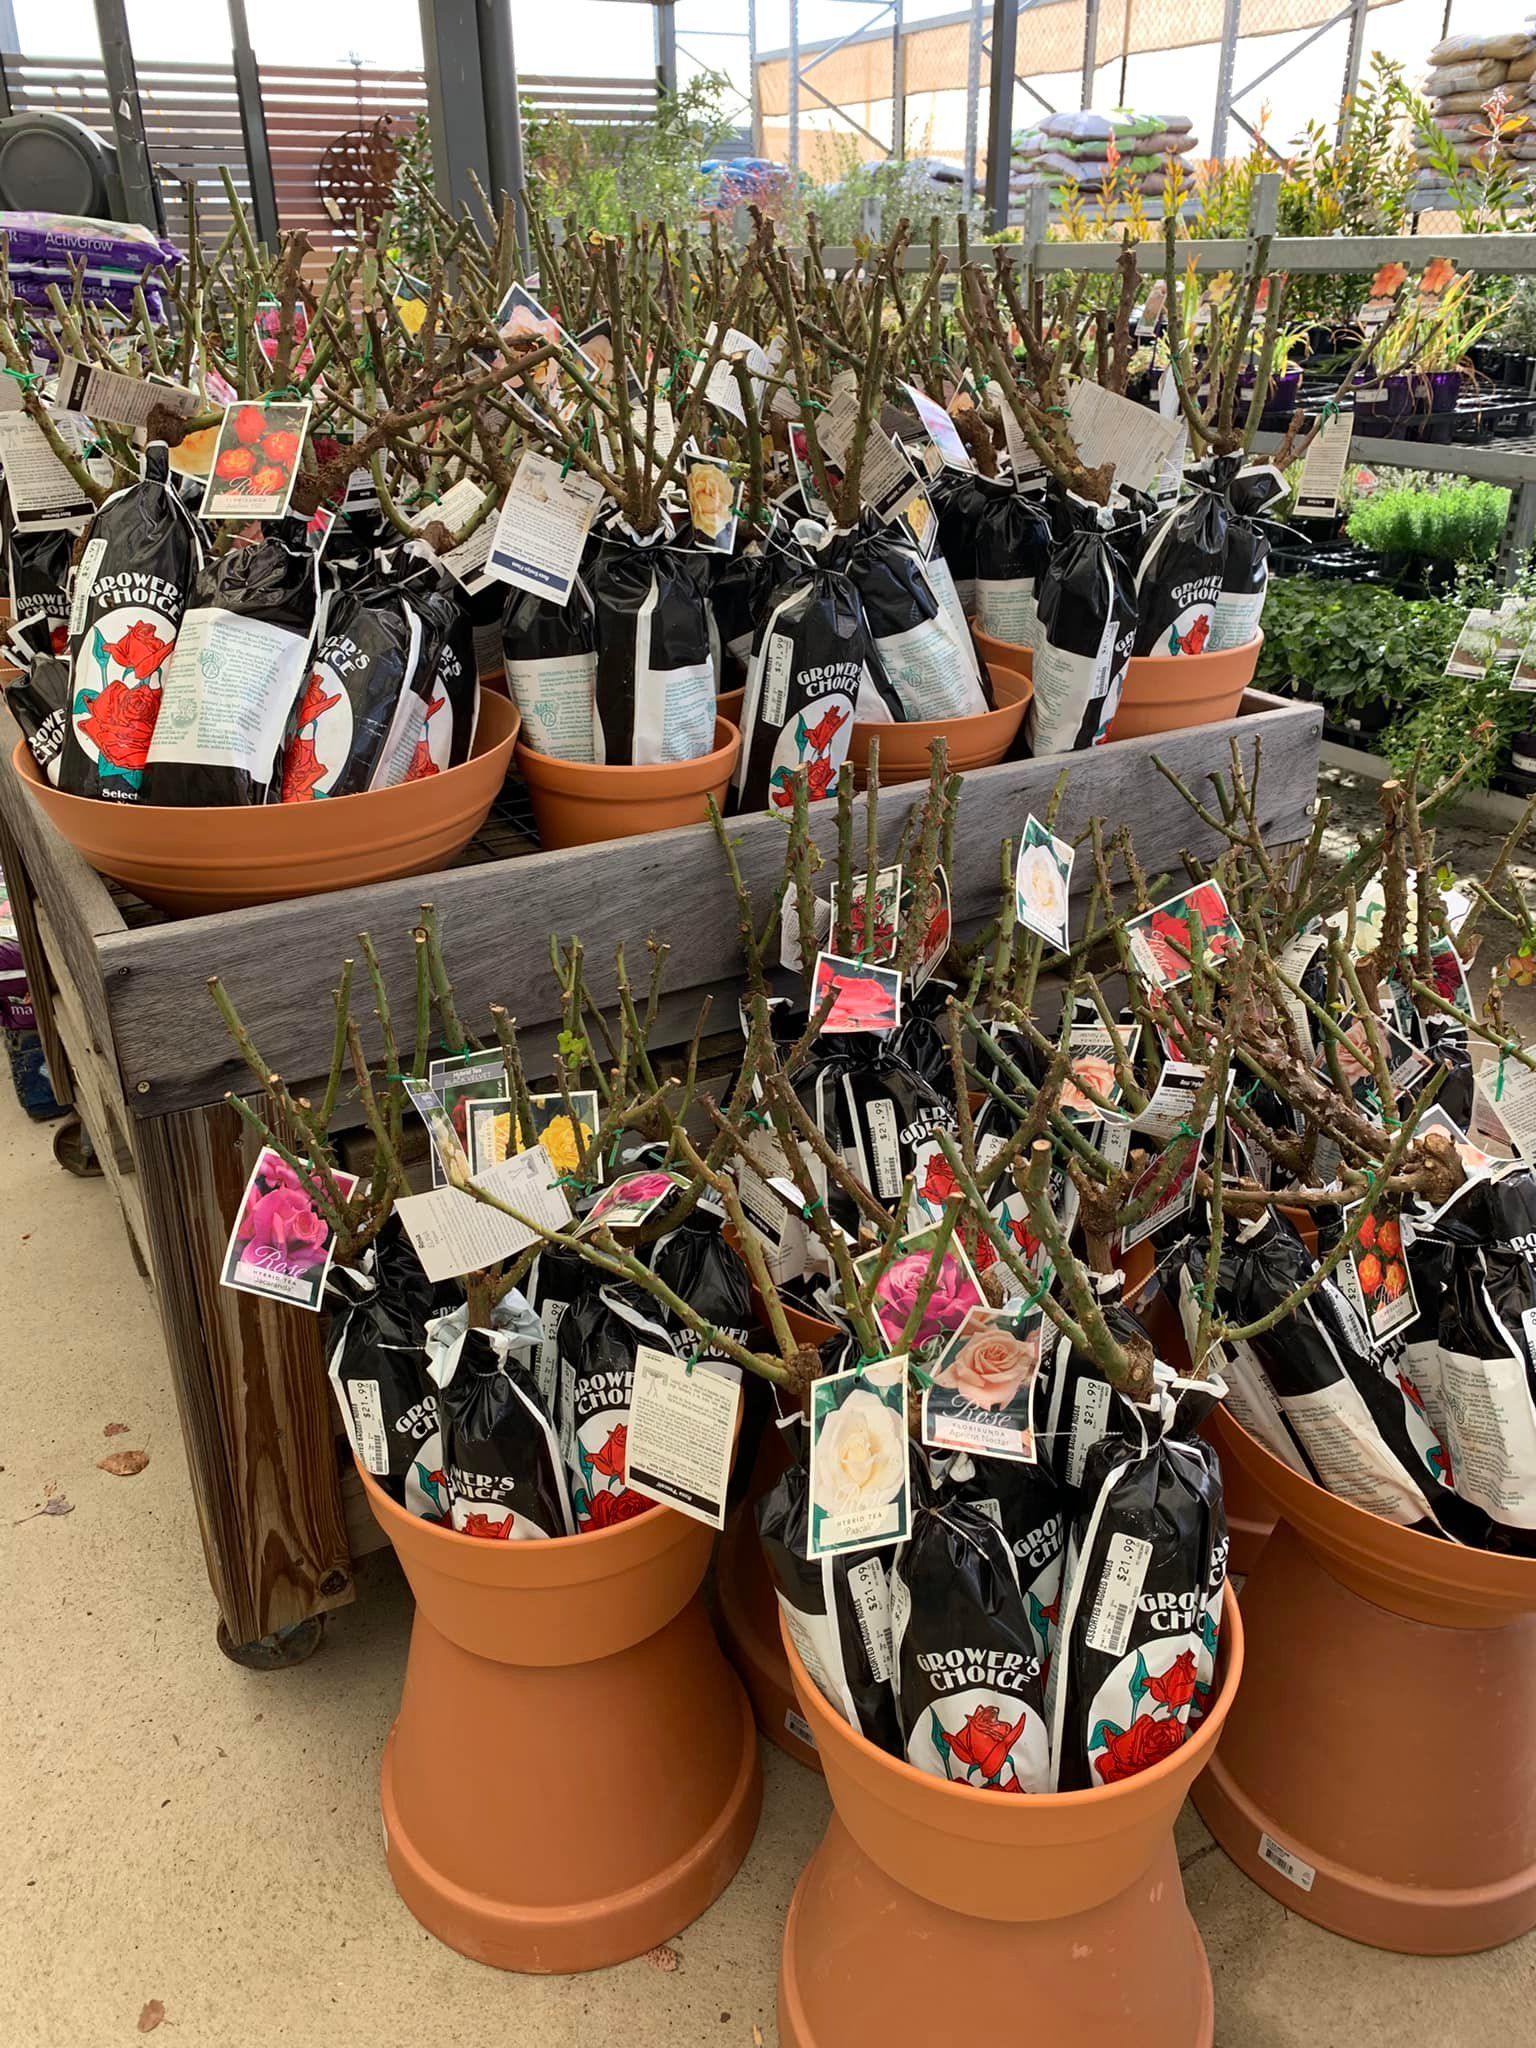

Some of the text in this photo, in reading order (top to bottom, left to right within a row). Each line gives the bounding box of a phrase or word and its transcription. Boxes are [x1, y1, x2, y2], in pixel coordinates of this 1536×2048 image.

[45, 232, 114, 252] ActivGrow
[98, 589, 182, 621] CHOICE
[774, 637, 785, 673] $21.99
[806, 675, 859, 697] CHOICE
[875, 1103, 888, 1139] $21.99
[253, 1269, 297, 1286] HYBRID TEA
[254, 1246, 309, 1279] Rose
[1346, 1262, 1357, 1300] $21.99
[549, 1303, 560, 1341] $21.99
[357, 1383, 371, 1418] $21.99
[577, 1388, 632, 1415] CHOI
[942, 1393, 1012, 1427] Rose
[1084, 1382, 1097, 1425] $21.99
[448, 1479, 506, 1502] OICE
[451, 1464, 515, 1490] WER'S
[836, 1511, 883, 1527] HYBRID TEA
[1117, 1538, 1137, 1582] $21.99
[858, 1567, 878, 1612] $21.99
[1086, 1560, 1114, 1644] ASSORTED BAGGED ROSES
[867, 1647, 882, 1681] ASSORTED
[916, 1647, 1041, 1676] GROWER'S
[929, 1664, 1032, 1692] CHOICE
